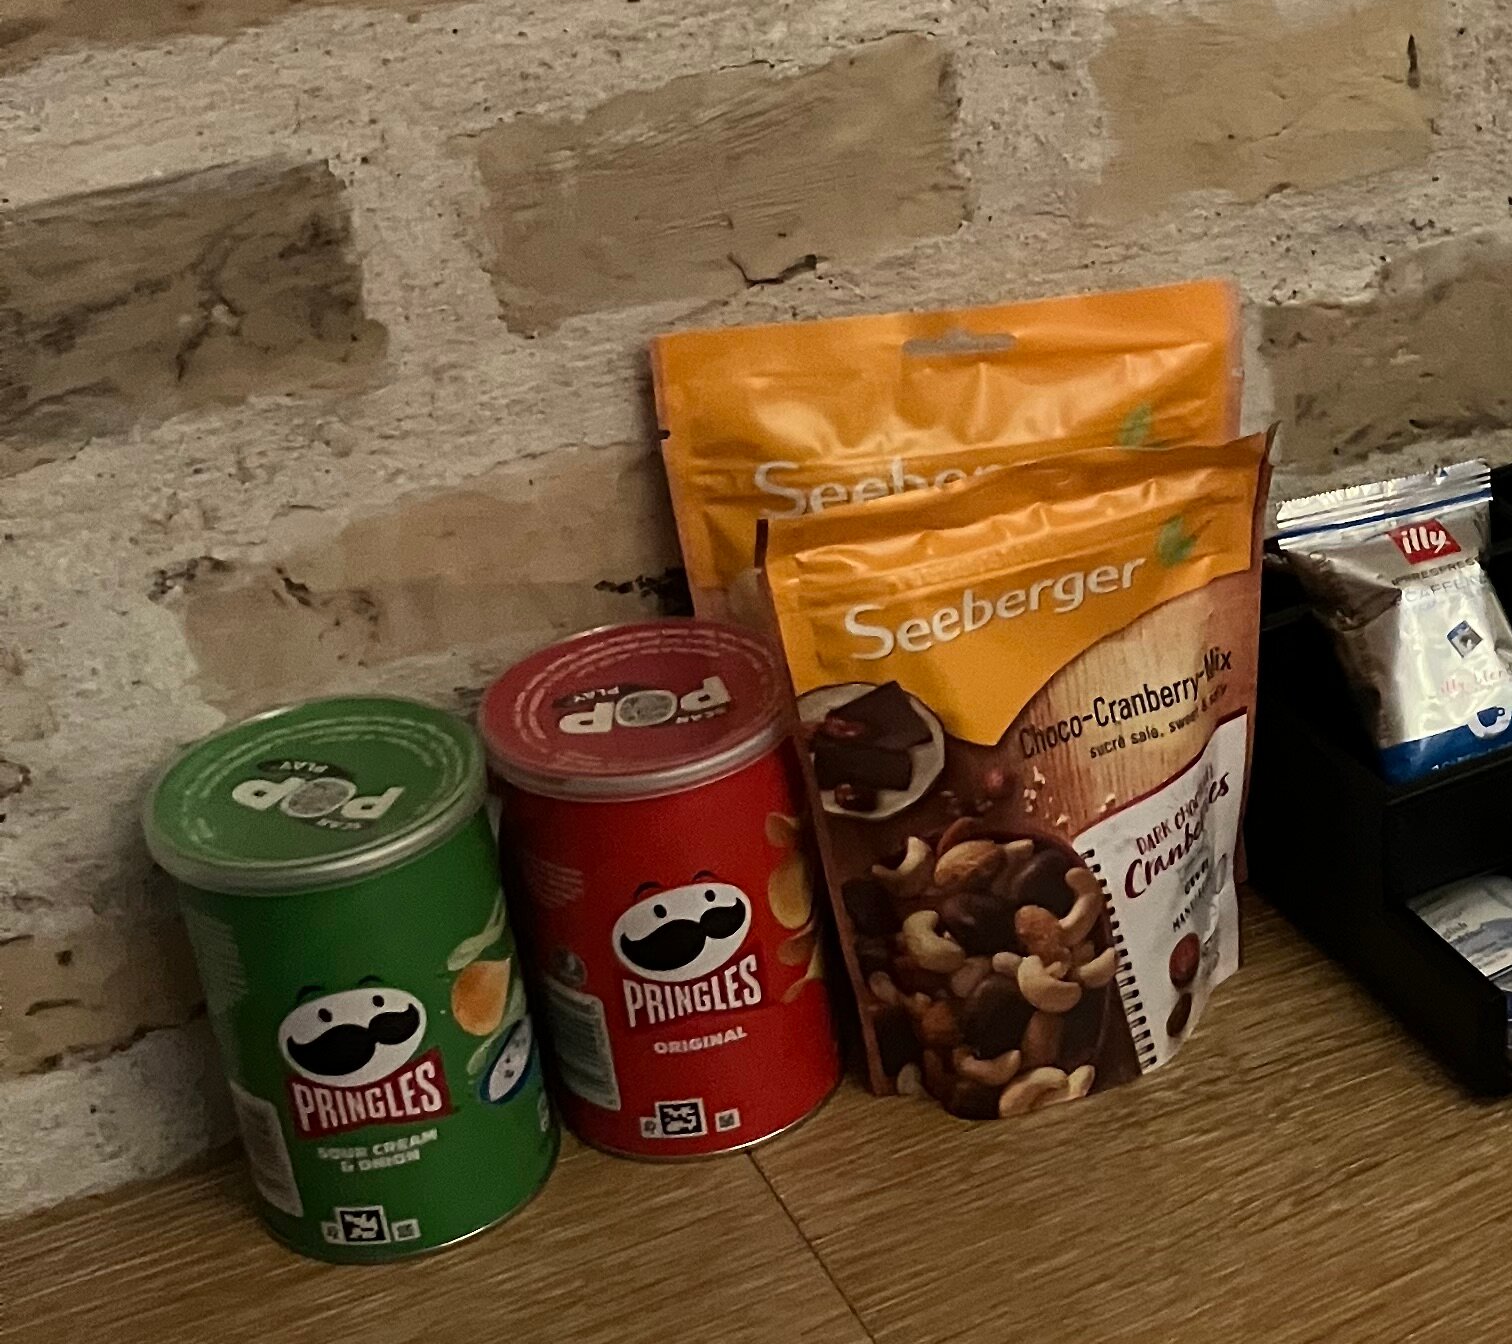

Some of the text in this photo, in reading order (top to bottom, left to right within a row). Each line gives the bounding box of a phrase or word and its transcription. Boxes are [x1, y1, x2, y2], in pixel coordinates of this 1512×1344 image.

[1400, 526, 1448, 554] illy
[844, 557, 1148, 661] Seeberger
[573, 686, 620, 703] PLAY
[279, 760, 330, 774] PLAY
[1135, 818, 1173, 856] DARK
[620, 953, 763, 1029] PRINGLES
[653, 1025, 749, 1055] ORIGINAL
[293, 1060, 443, 1133] PRINGLES
[317, 1128, 439, 1160] SOUR CREAM
[358, 1148, 421, 1171] ONION
